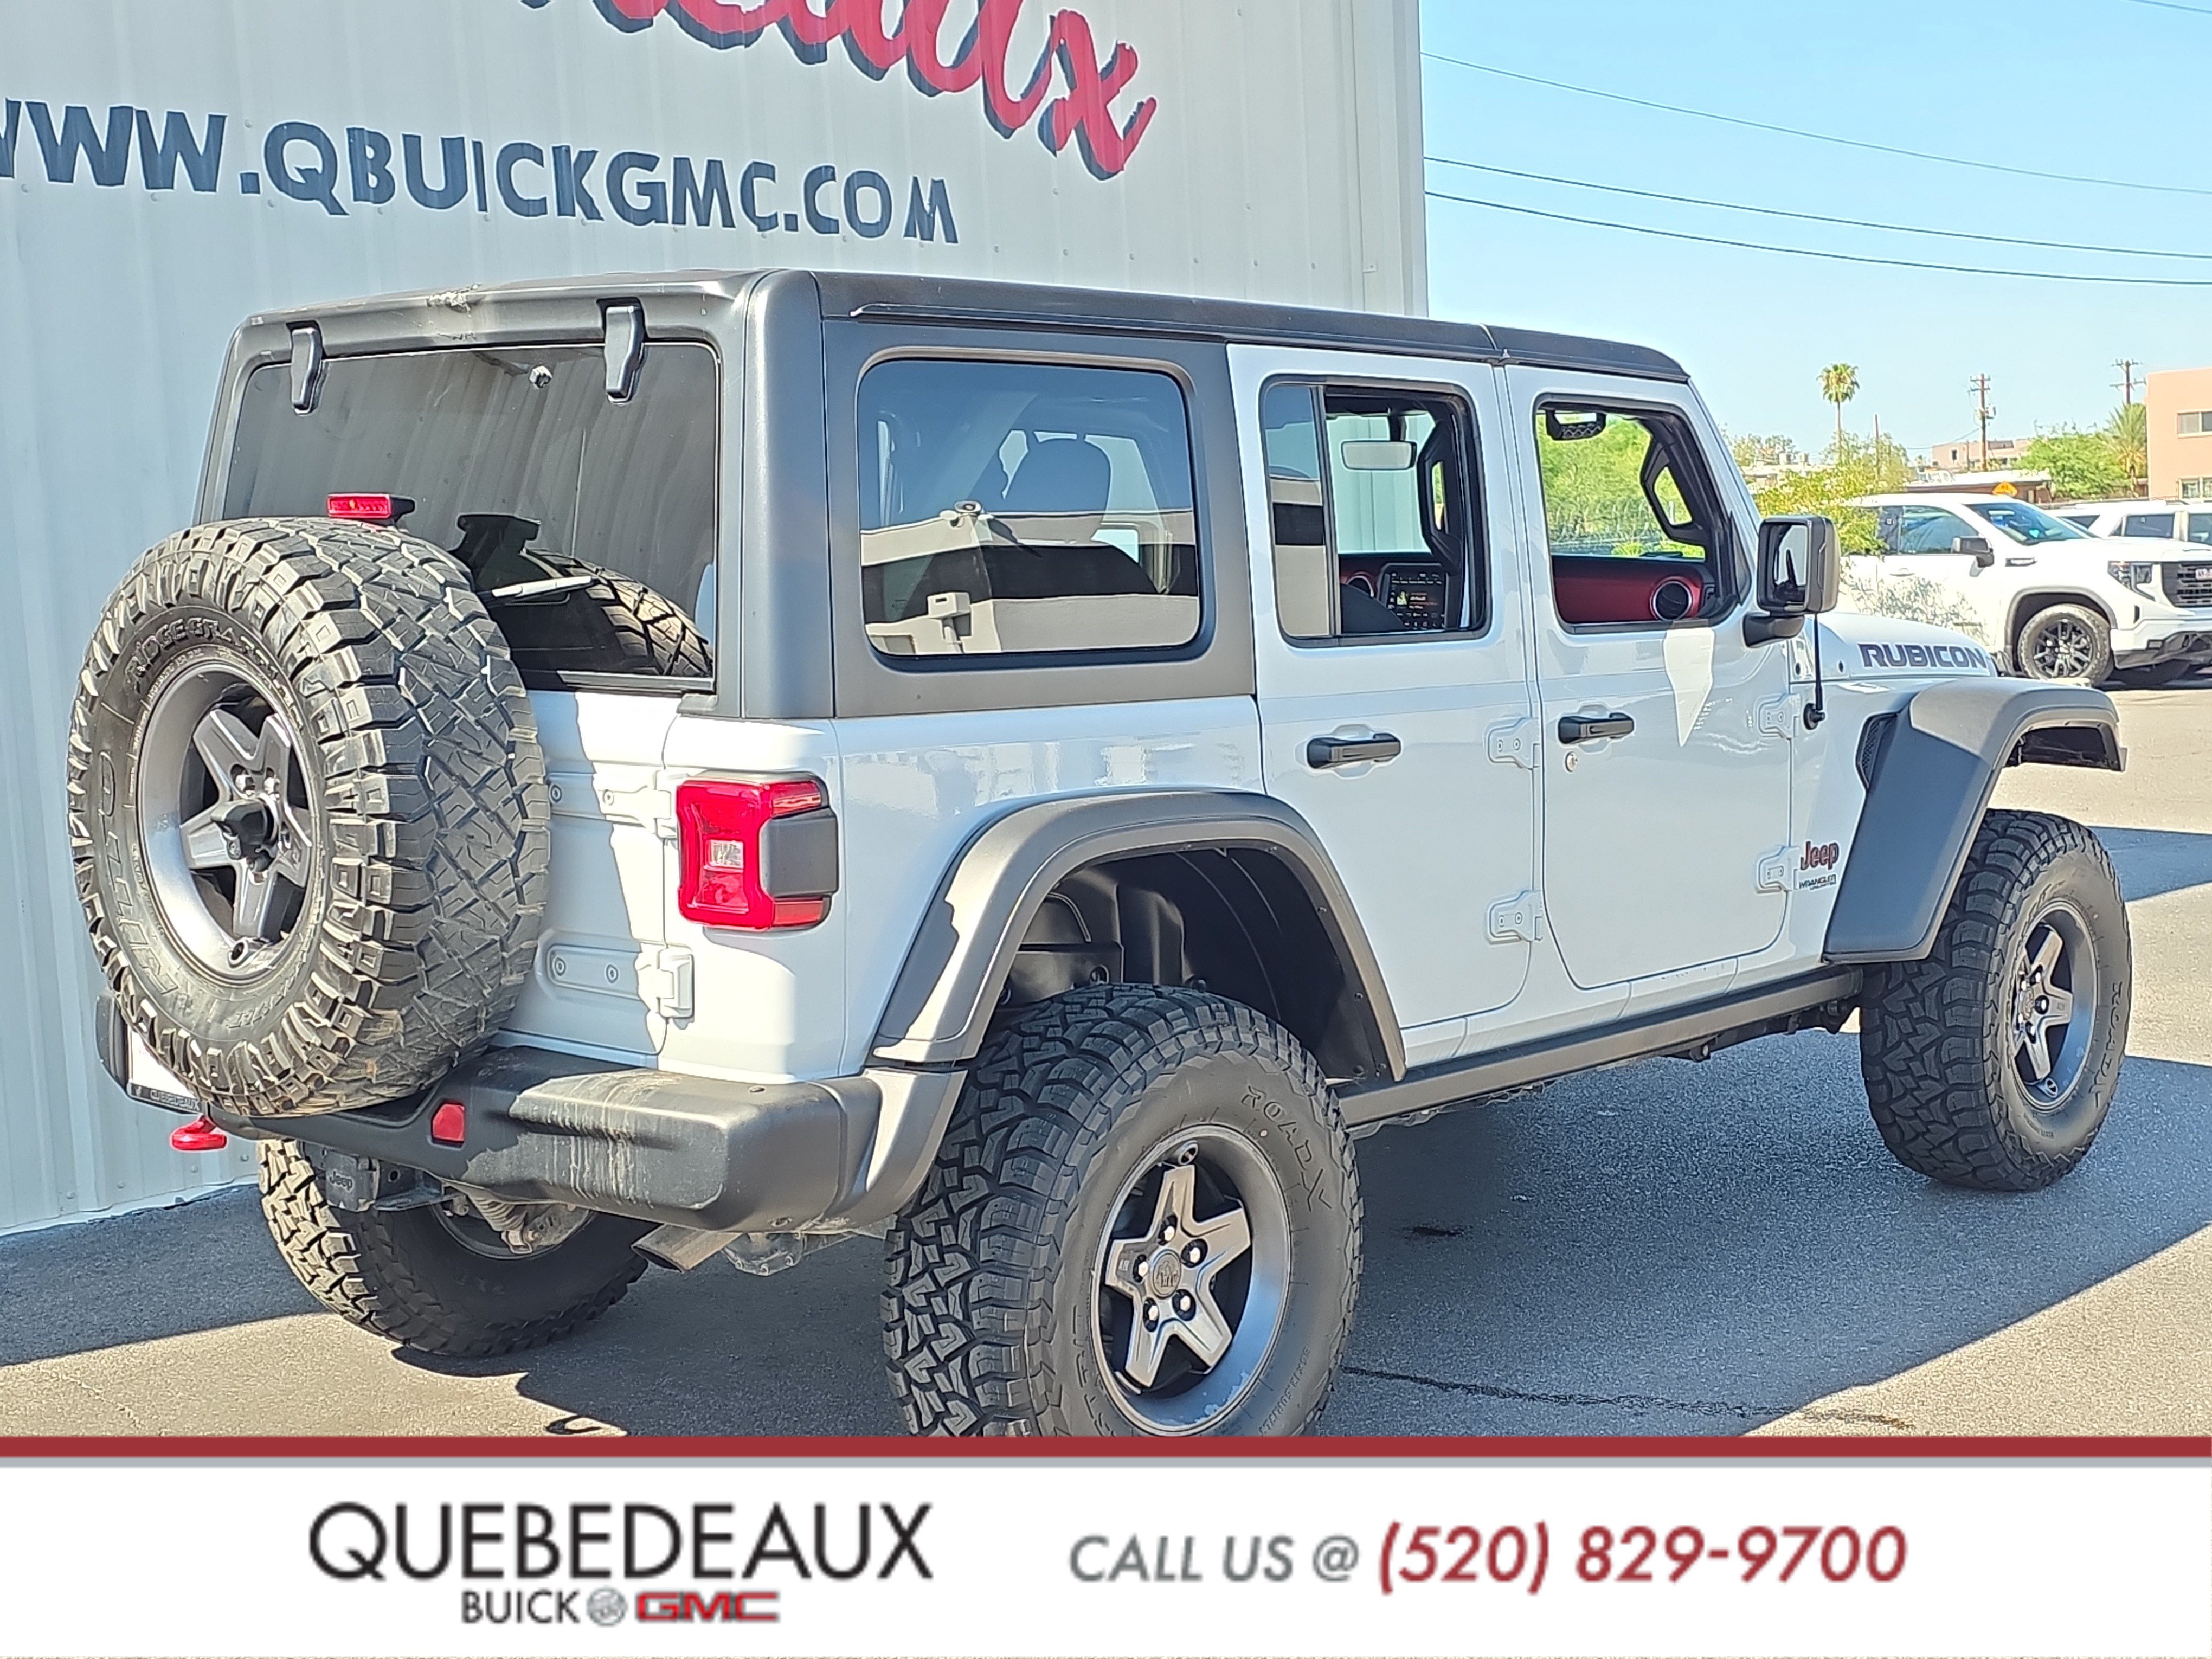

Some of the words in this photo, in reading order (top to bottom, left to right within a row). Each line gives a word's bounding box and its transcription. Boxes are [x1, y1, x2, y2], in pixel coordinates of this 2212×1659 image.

[0, 98, 959, 244] WW.QBUICKGMC.COM
[1857, 643, 1987, 669] RUBICON
[1800, 841, 1839, 870] Jeep
[329, 1171, 353, 1192] Jeep
